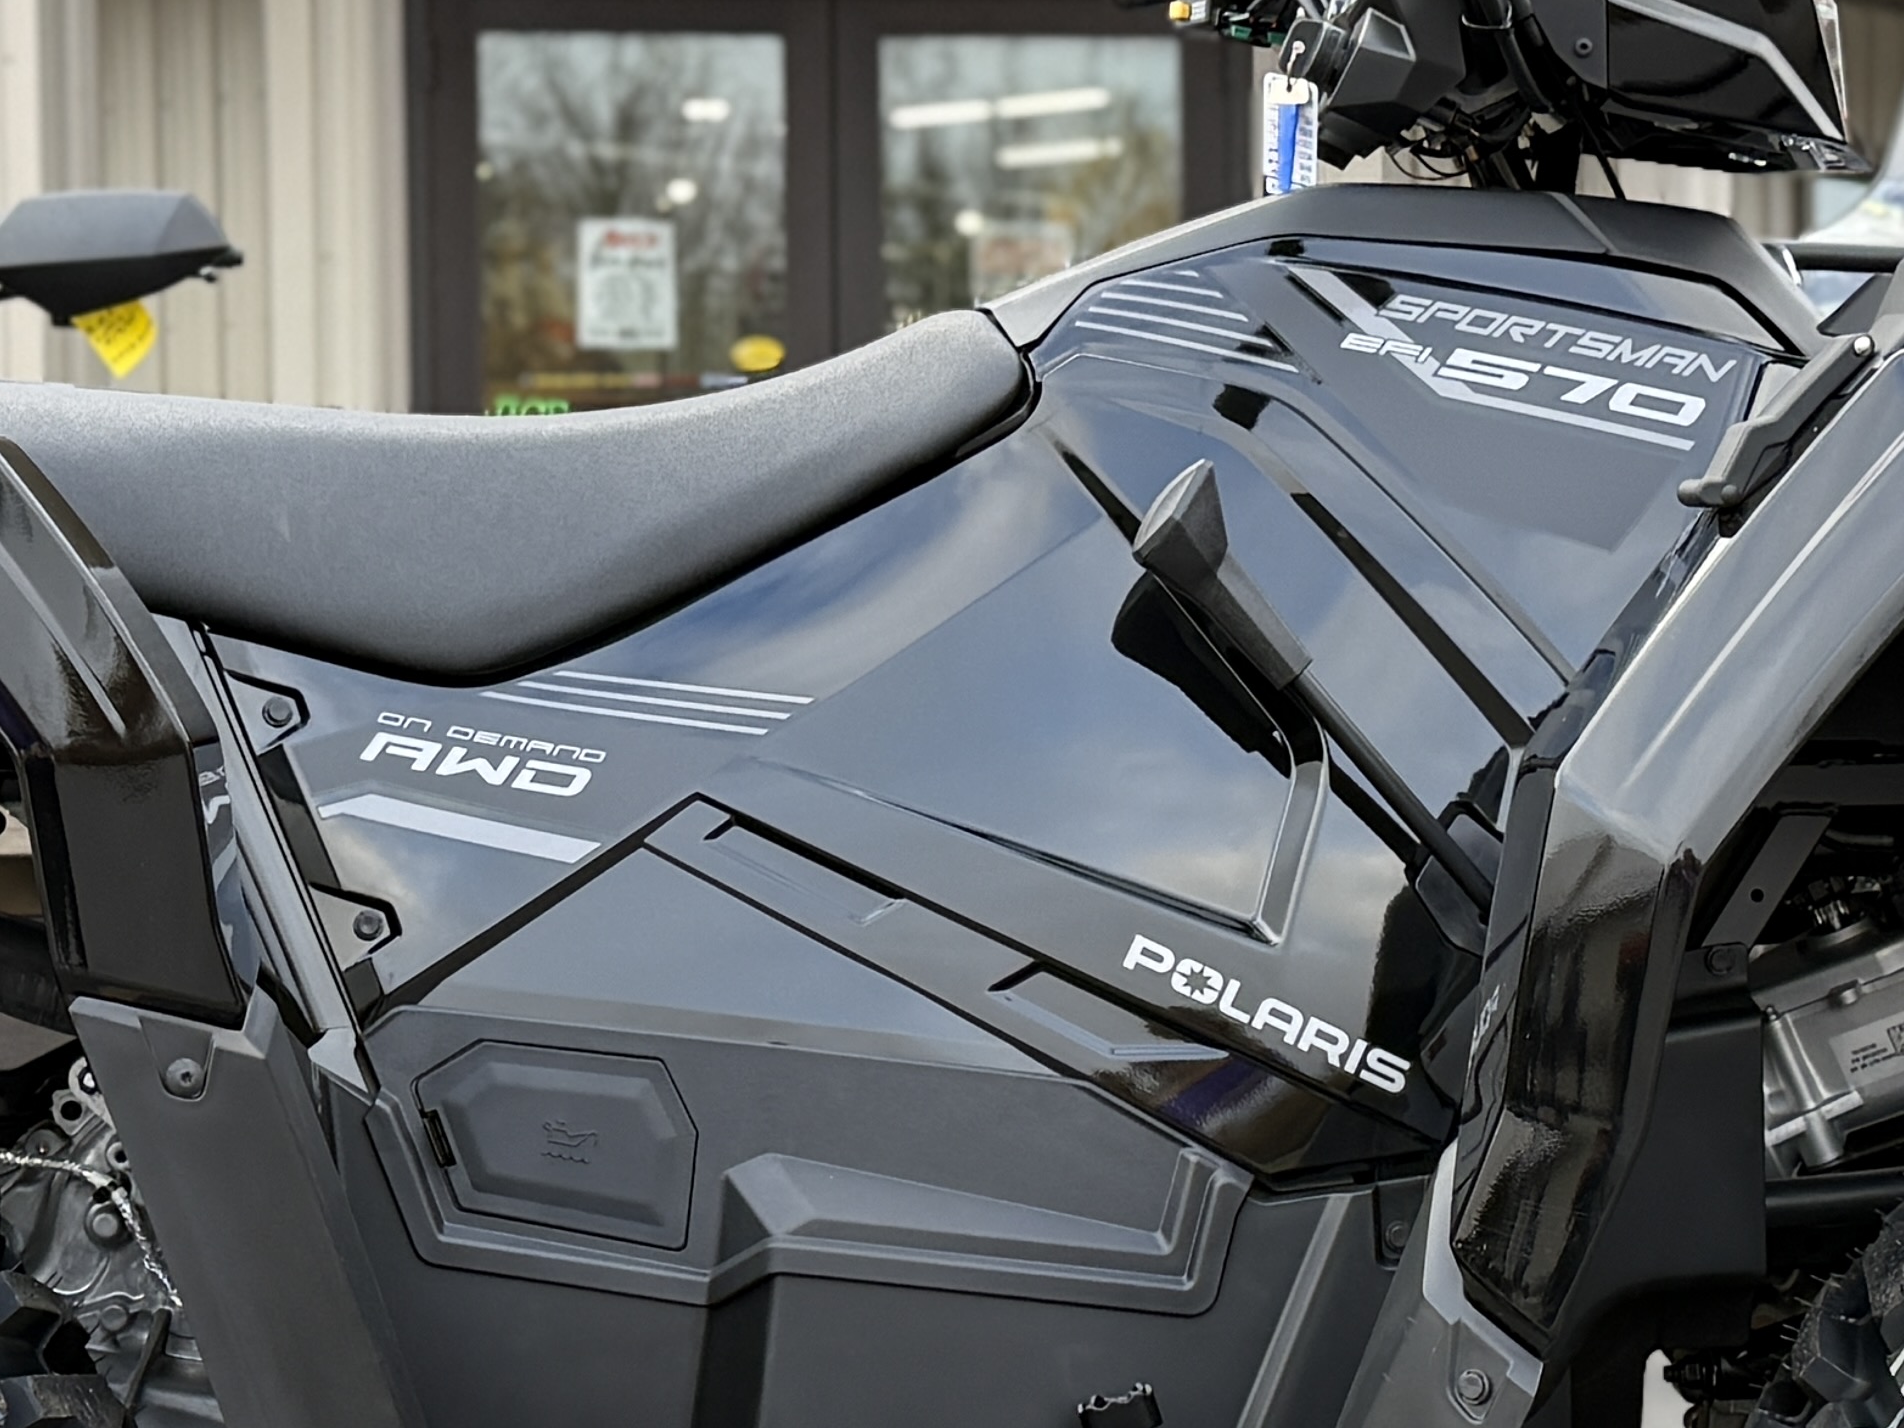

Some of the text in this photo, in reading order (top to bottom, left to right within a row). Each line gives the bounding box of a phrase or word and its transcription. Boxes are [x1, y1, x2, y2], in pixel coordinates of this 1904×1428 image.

[1339, 331, 1707, 428] EFI 570
[1376, 293, 1737, 384] SPORTSMAN
[358, 730, 593, 798] AWD
[376, 710, 607, 764] ON DEMAND
[1122, 933, 1412, 1095] POLARIS
